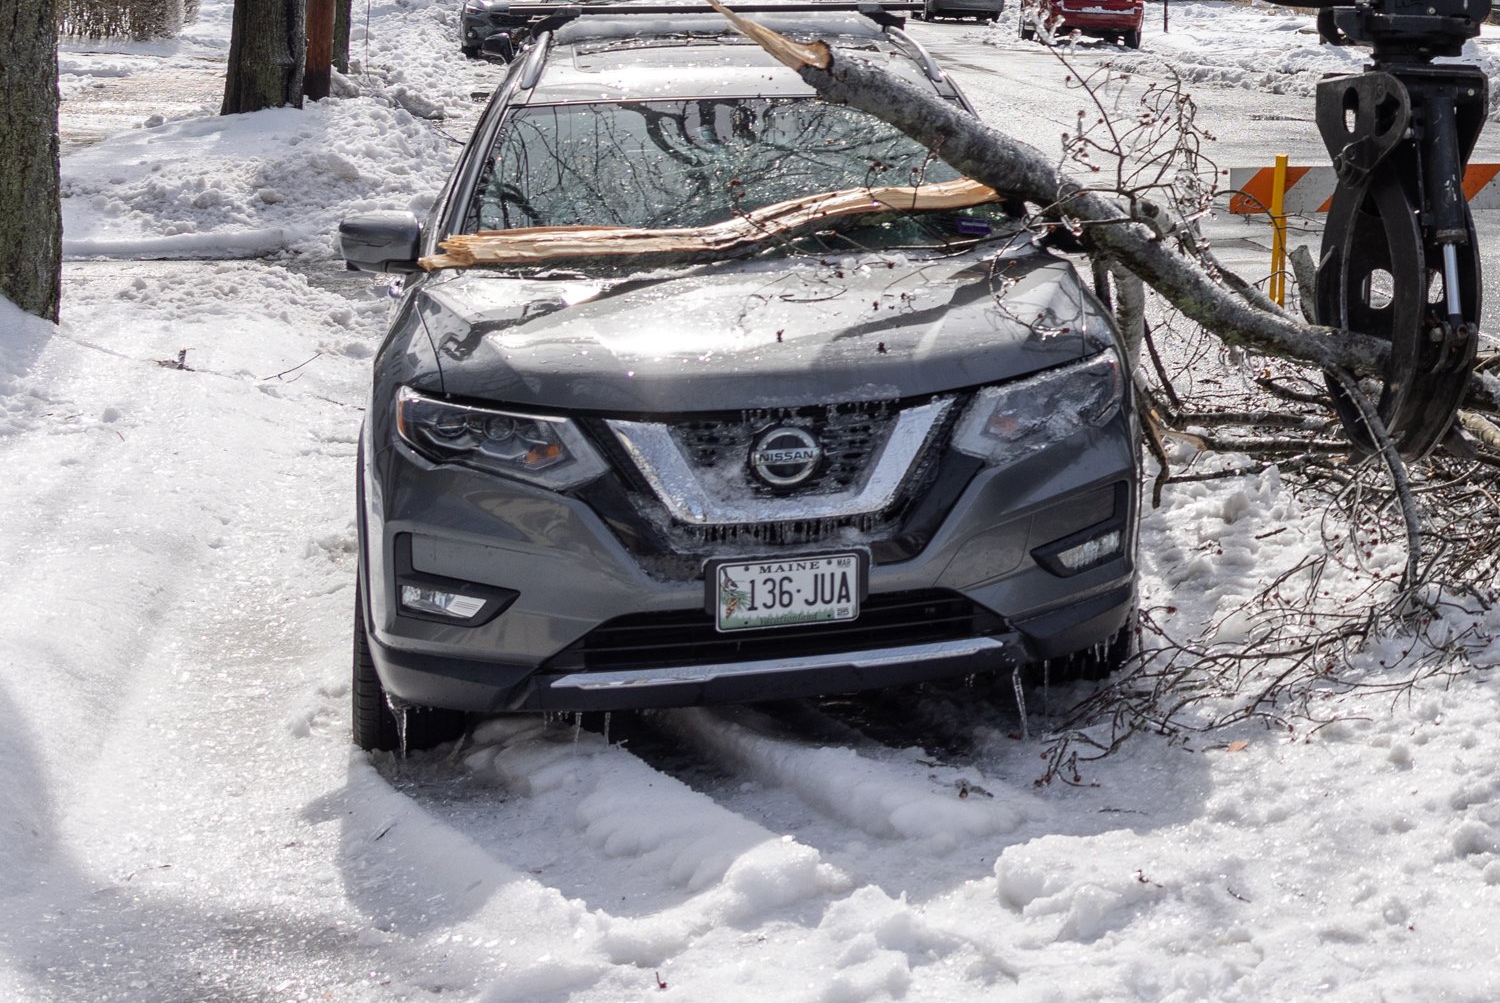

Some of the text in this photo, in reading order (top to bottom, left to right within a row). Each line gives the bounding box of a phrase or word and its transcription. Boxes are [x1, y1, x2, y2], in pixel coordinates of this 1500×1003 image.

[759, 451, 814, 462] NISSAN
[759, 561, 820, 574] MAINE
[837, 558, 851, 567] MAR
[760, 612, 818, 625] Vacationland
